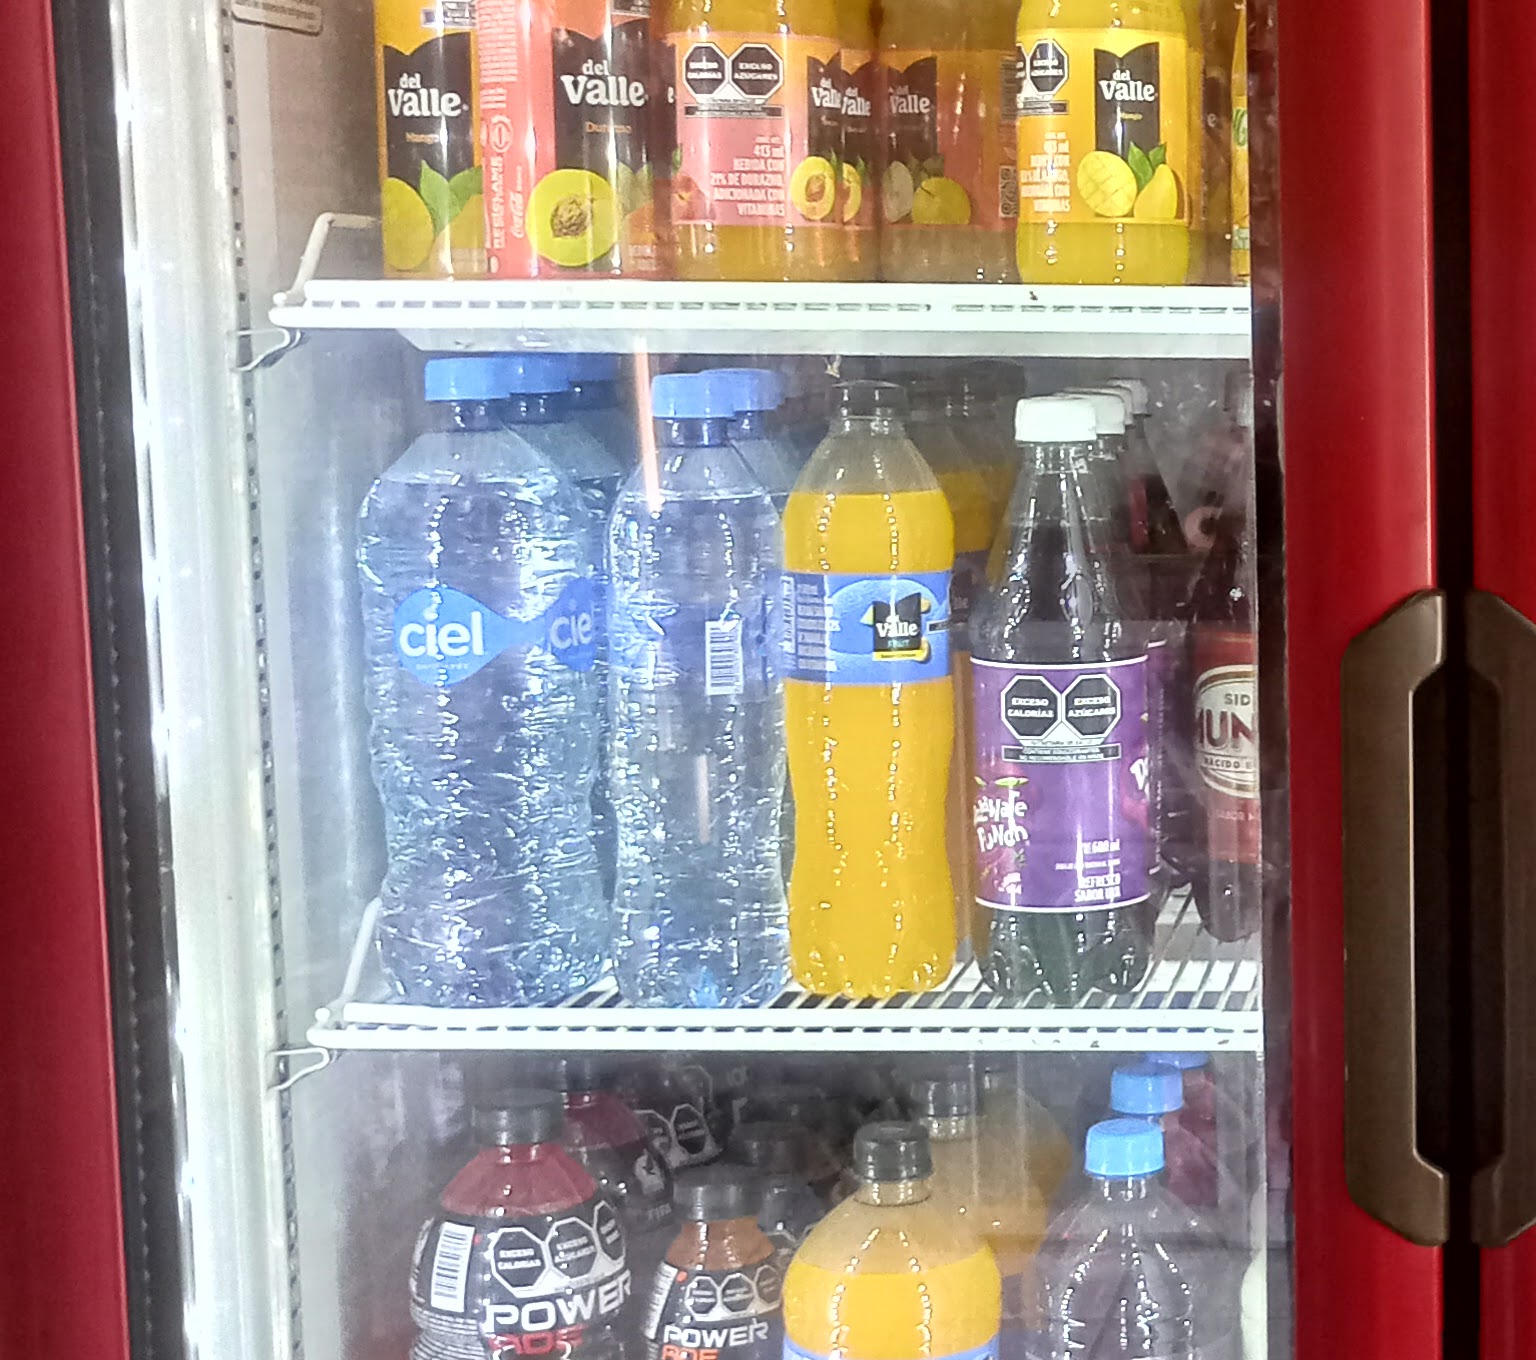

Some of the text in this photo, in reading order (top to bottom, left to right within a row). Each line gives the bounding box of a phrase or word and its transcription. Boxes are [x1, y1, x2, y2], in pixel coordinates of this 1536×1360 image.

[582, 59, 608, 76] del
[1113, 69, 1131, 81] del
[400, 73, 421, 89] del
[561, 75, 646, 106] Valle
[1099, 80, 1156, 102] Valle
[388, 89, 462, 117] Valle
[889, 94, 930, 114] Valle
[400, 608, 484, 657] ciel
[550, 610, 593, 650] cie
[876, 621, 919, 638] Valle
[1011, 697, 1049, 706] EXCESO
[1073, 696, 1112, 706] EXCESO
[1224, 692, 1251, 707] SID
[1007, 708, 1054, 718] CALORÍAS
[483, 1269, 632, 1333] POWER
[663, 1321, 770, 1348] POWER
